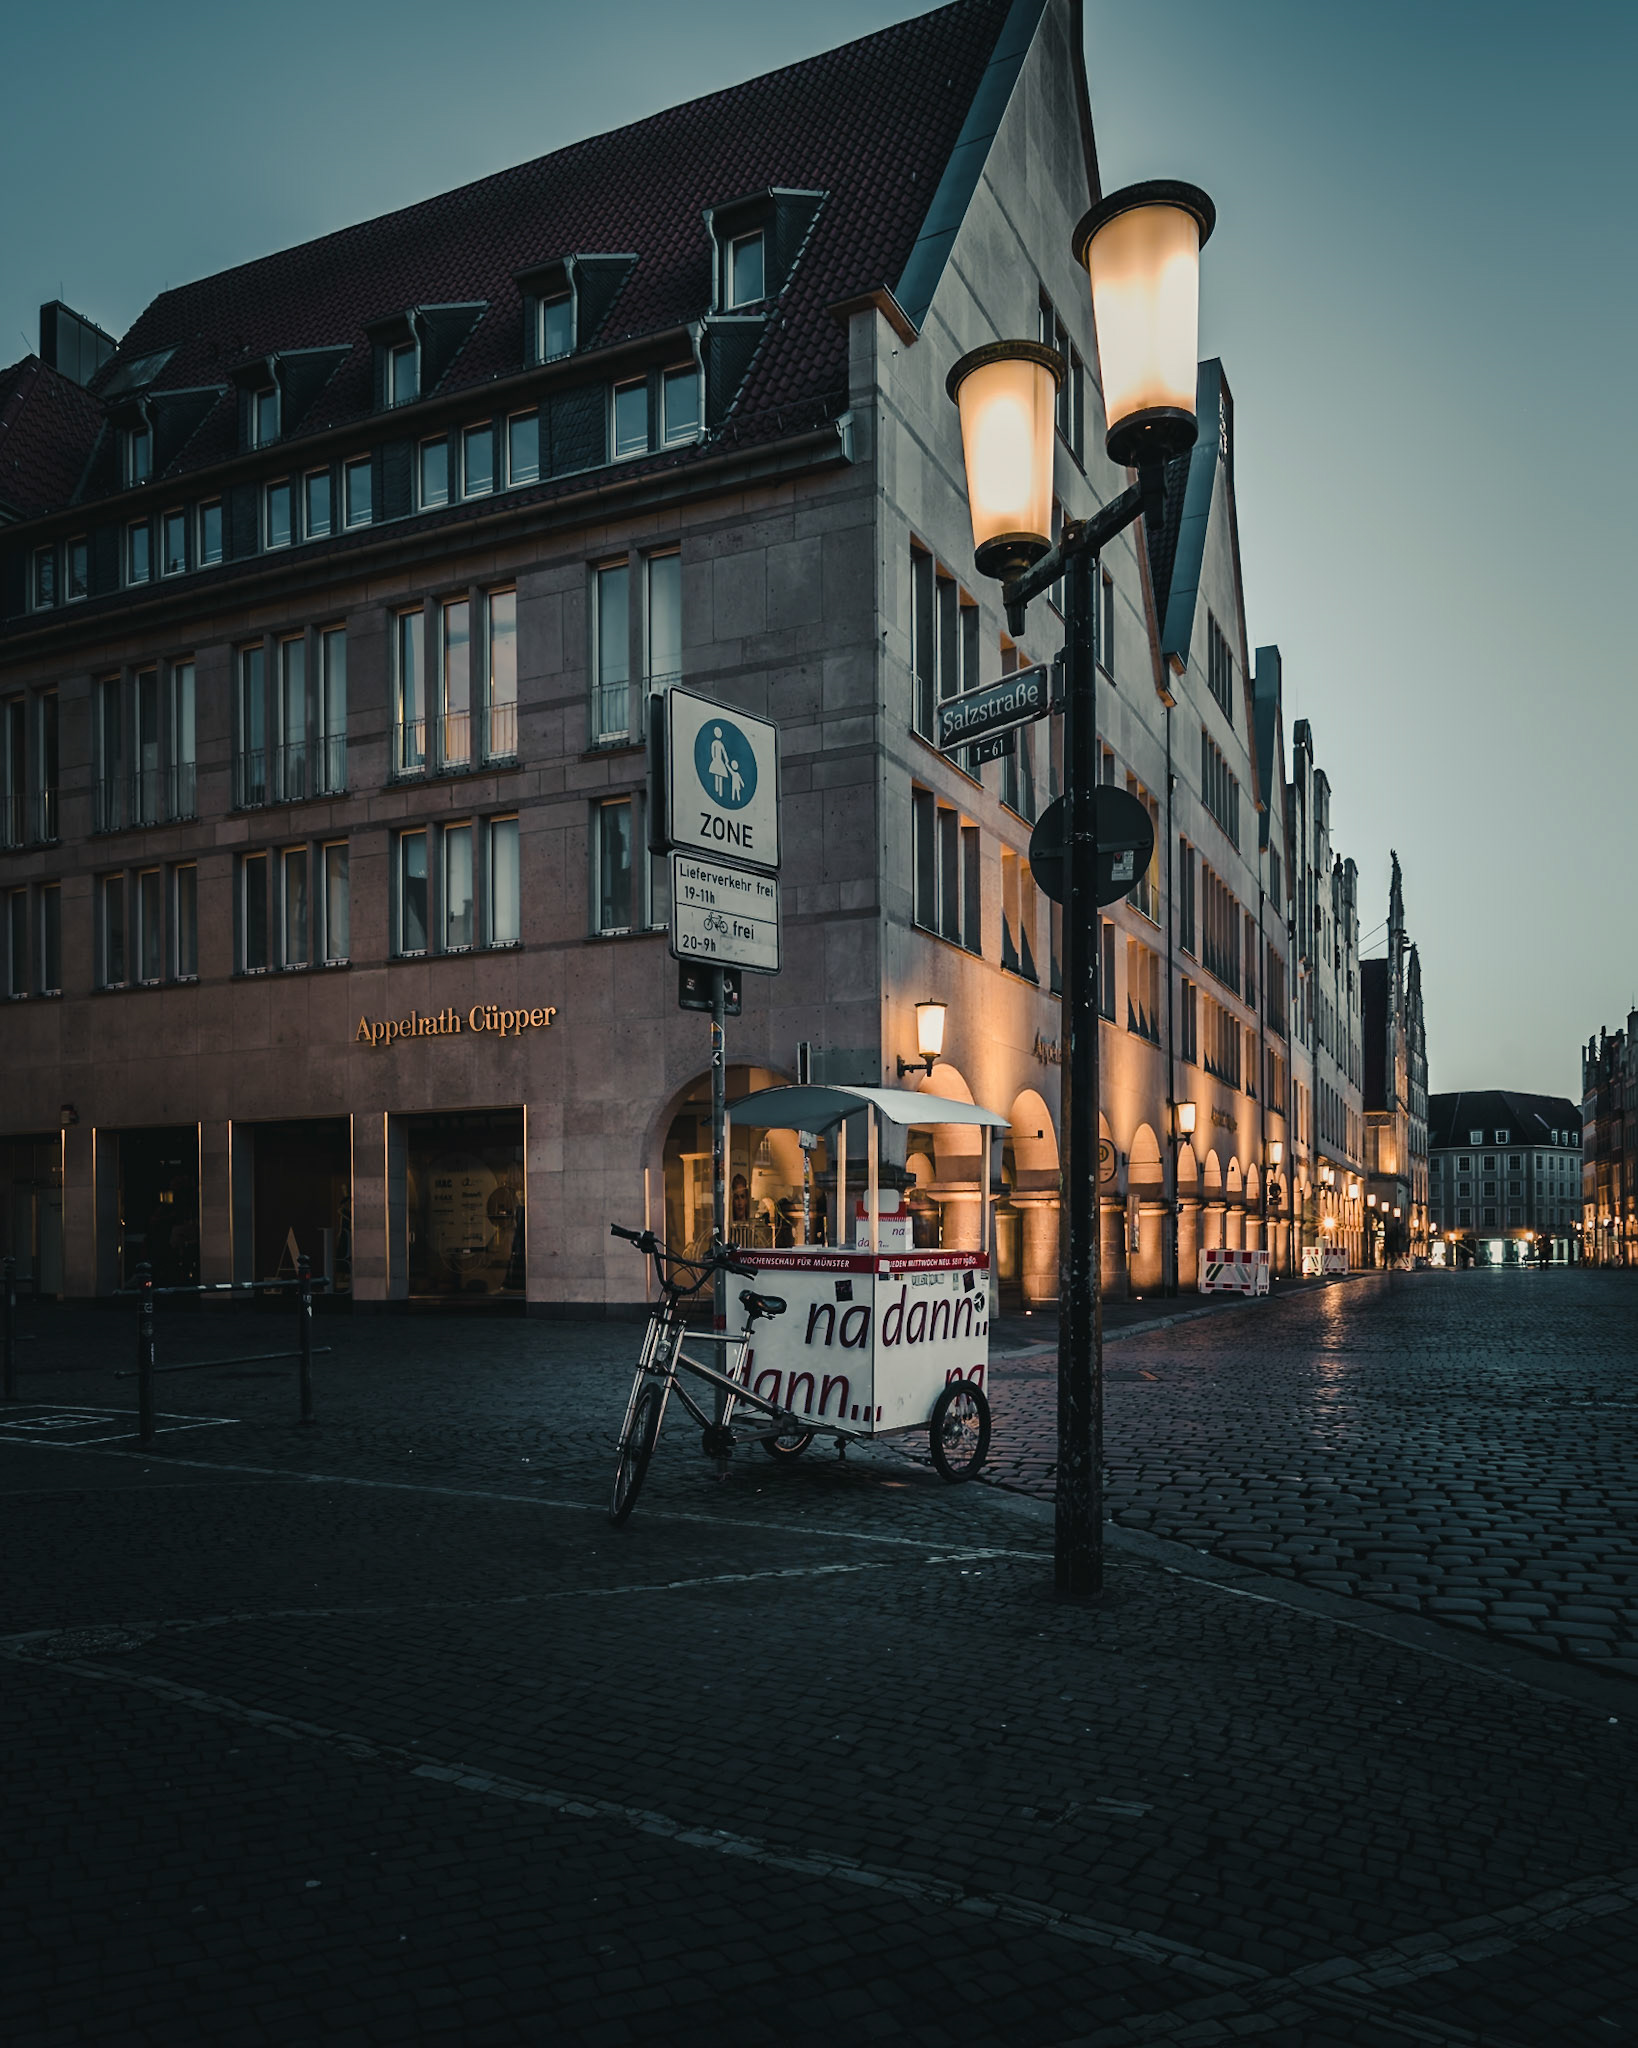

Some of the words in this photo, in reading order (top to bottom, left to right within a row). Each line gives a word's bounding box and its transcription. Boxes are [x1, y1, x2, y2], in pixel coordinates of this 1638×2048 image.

[943, 683, 1039, 738] Salzstraße
[700, 812, 753, 849] ZONE
[679, 863, 752, 892] Lieferverkehr
[756, 883, 774, 898] frei
[684, 885, 715, 904] 19-11h
[732, 920, 754, 940] frei
[682, 934, 716, 953] 20-9h
[892, 1228, 905, 1236] na
[739, 1256, 795, 1267] WOCHENSCHAU
[797, 1256, 812, 1267] FÜR
[813, 1257, 850, 1268] MÜNSTER
[907, 1258, 938, 1267] MITTWOCH
[804, 1303, 872, 1349] na
